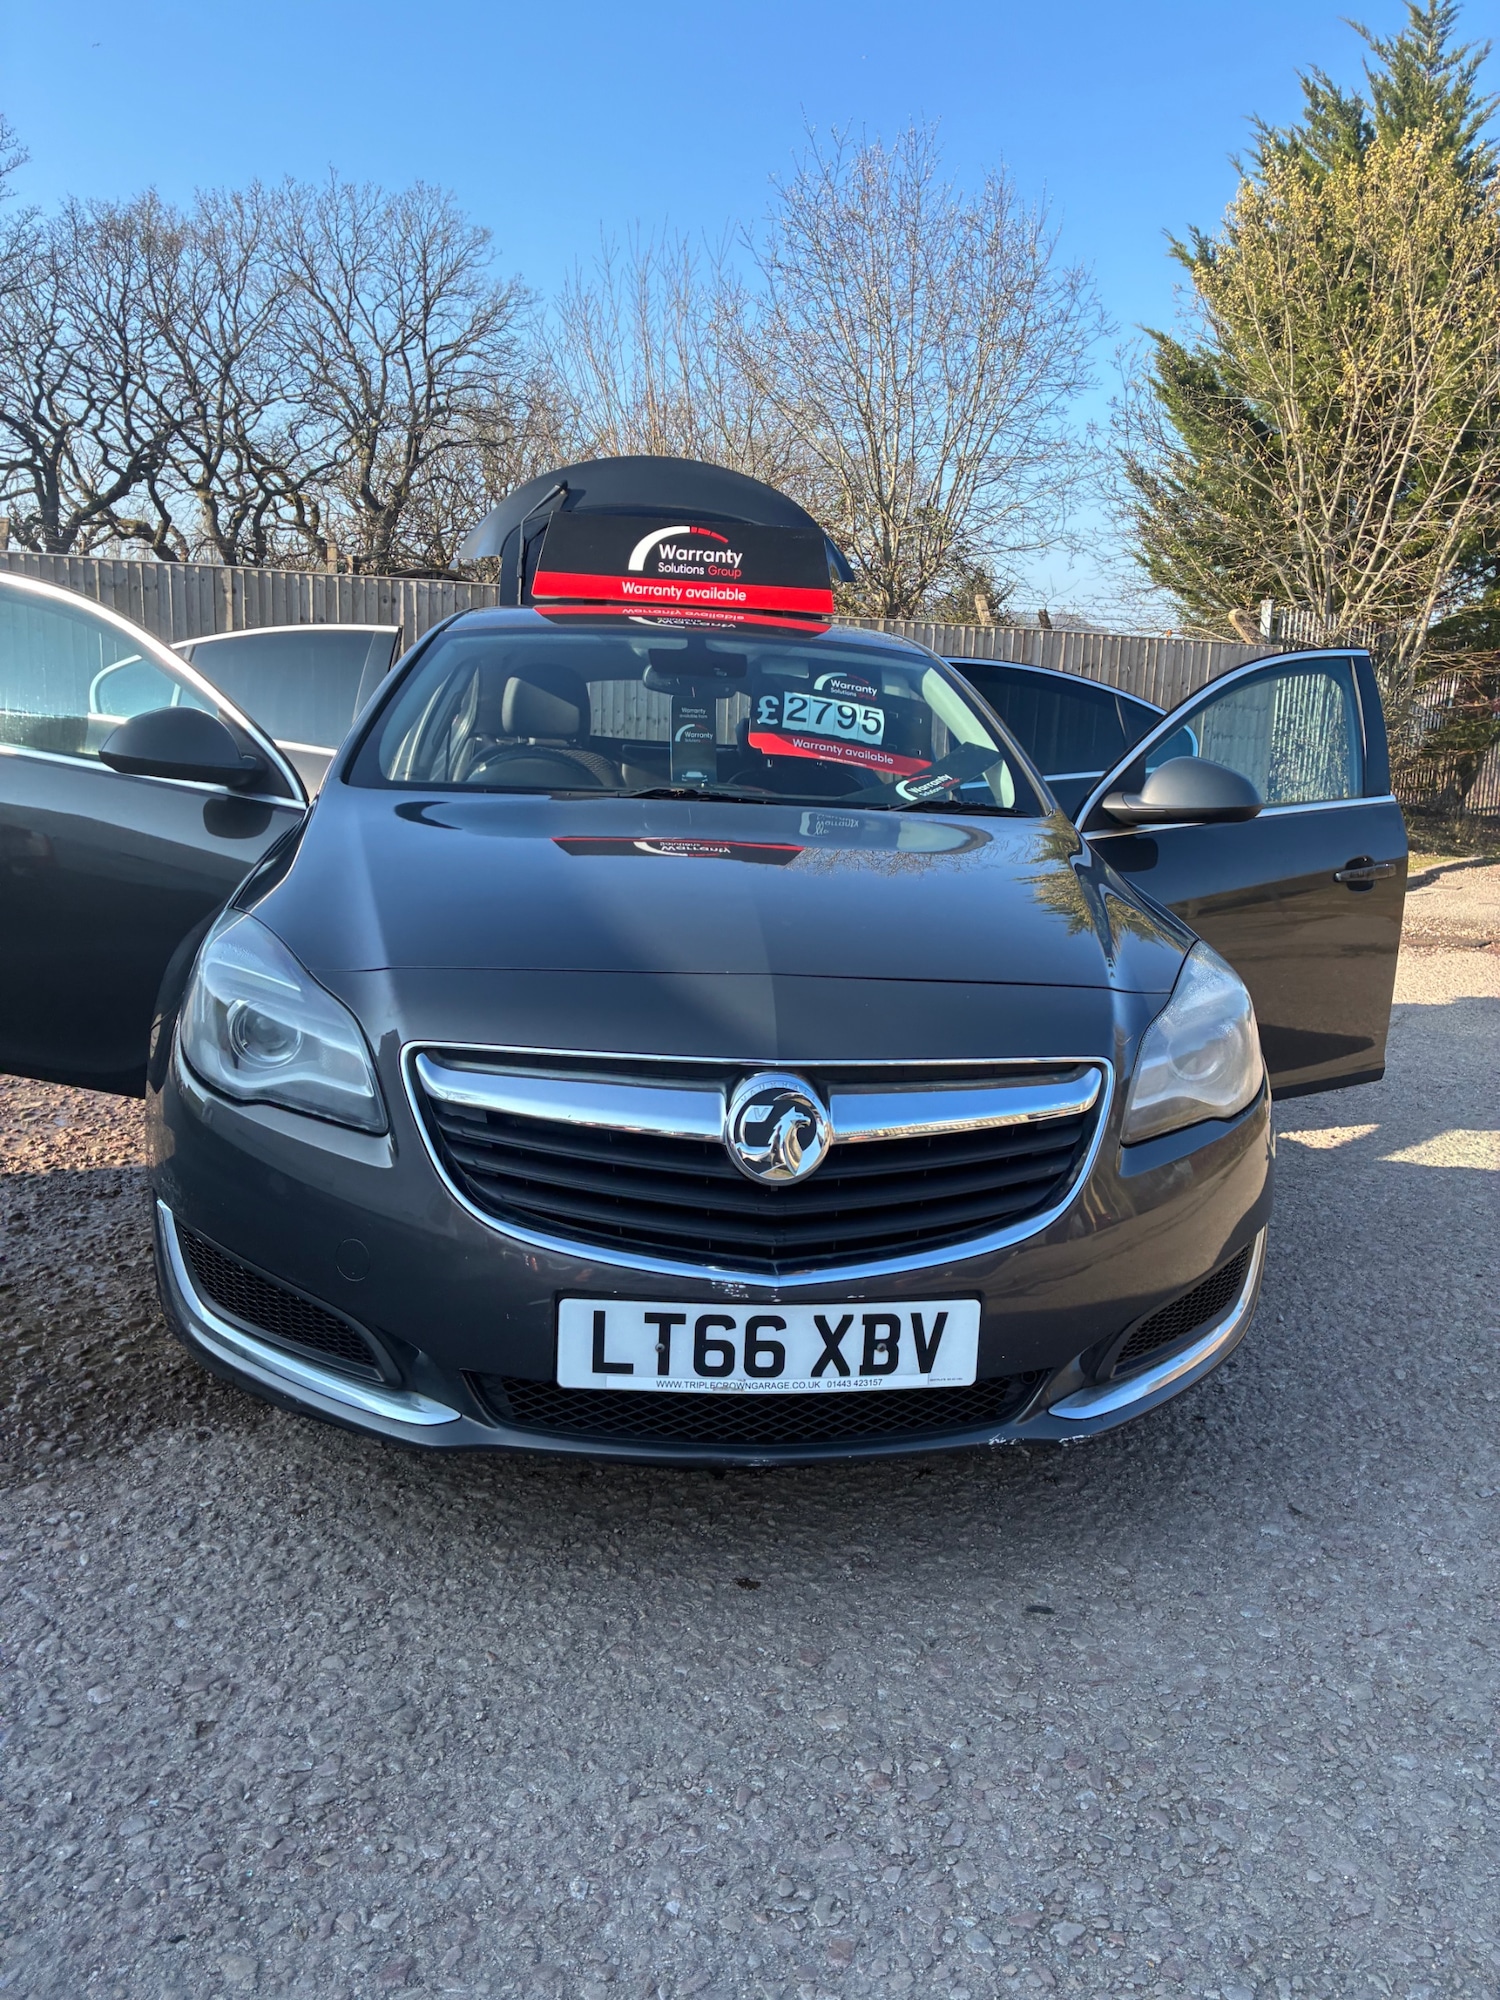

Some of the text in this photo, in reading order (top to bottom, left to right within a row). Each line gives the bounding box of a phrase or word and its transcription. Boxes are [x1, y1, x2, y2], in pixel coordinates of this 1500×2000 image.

[659, 543, 743, 568] Warranty
[658, 562, 742, 579] Solutions Group
[622, 581, 747, 601] Warranty available
[830, 679, 878, 696] Warranty
[830, 687, 857, 698] Solutions
[681, 707, 706, 715] Warranty
[757, 695, 882, 736] £2795
[684, 731, 713, 740] Warranty
[792, 738, 843, 756] Warranty
[845, 749, 894, 765] available
[907, 774, 953, 793] Warranty
[592, 1310, 949, 1378] LT66 XBV
[656, 1378, 883, 1390] WWW.TRIPLECROWNGARAGE.CO.UK 01443 423157
